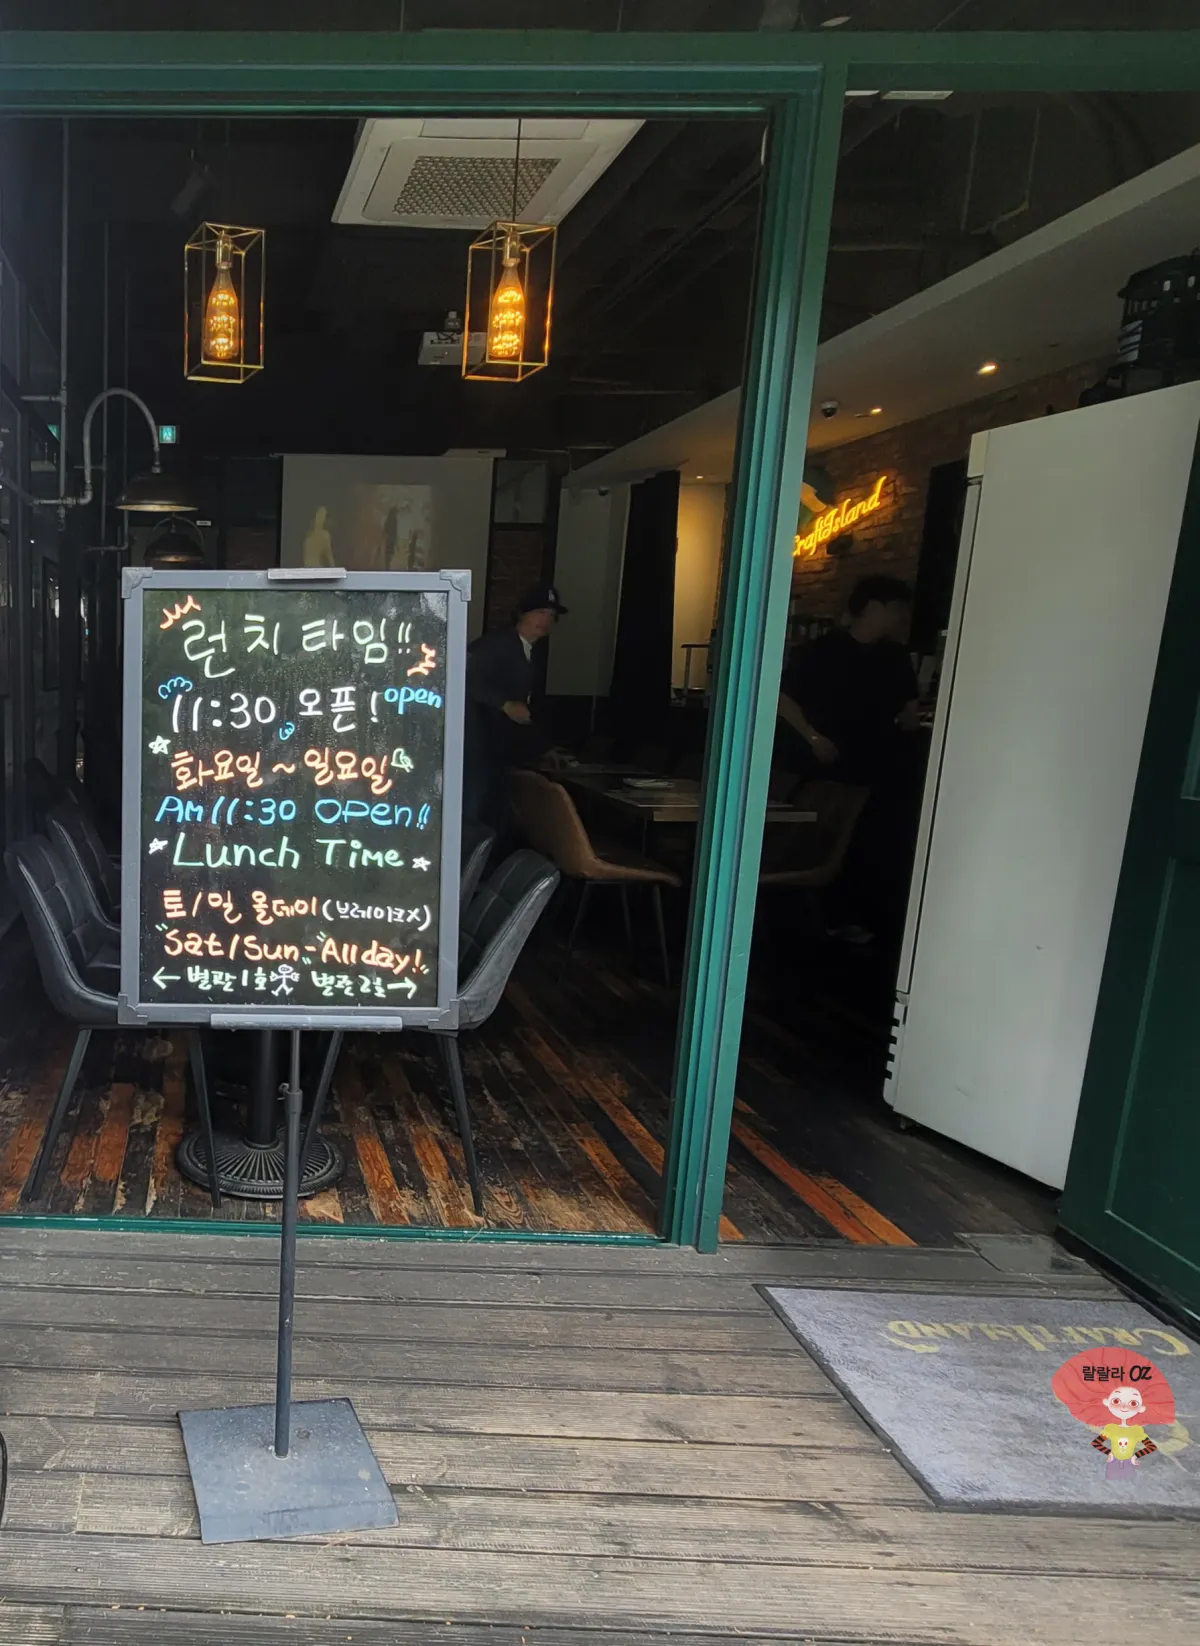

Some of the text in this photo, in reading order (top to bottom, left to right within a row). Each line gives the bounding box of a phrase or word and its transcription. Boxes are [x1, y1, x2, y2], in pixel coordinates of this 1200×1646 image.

[172, 686, 442, 733] 11:30 오픈! open
[171, 750, 264, 791] 화요일
[303, 747, 393, 795] 일요일
[211, 796, 297, 826] 11:30
[172, 832, 300, 869] Lunch
[163, 888, 243, 925] 토/일
[251, 890, 317, 926] 올데이
